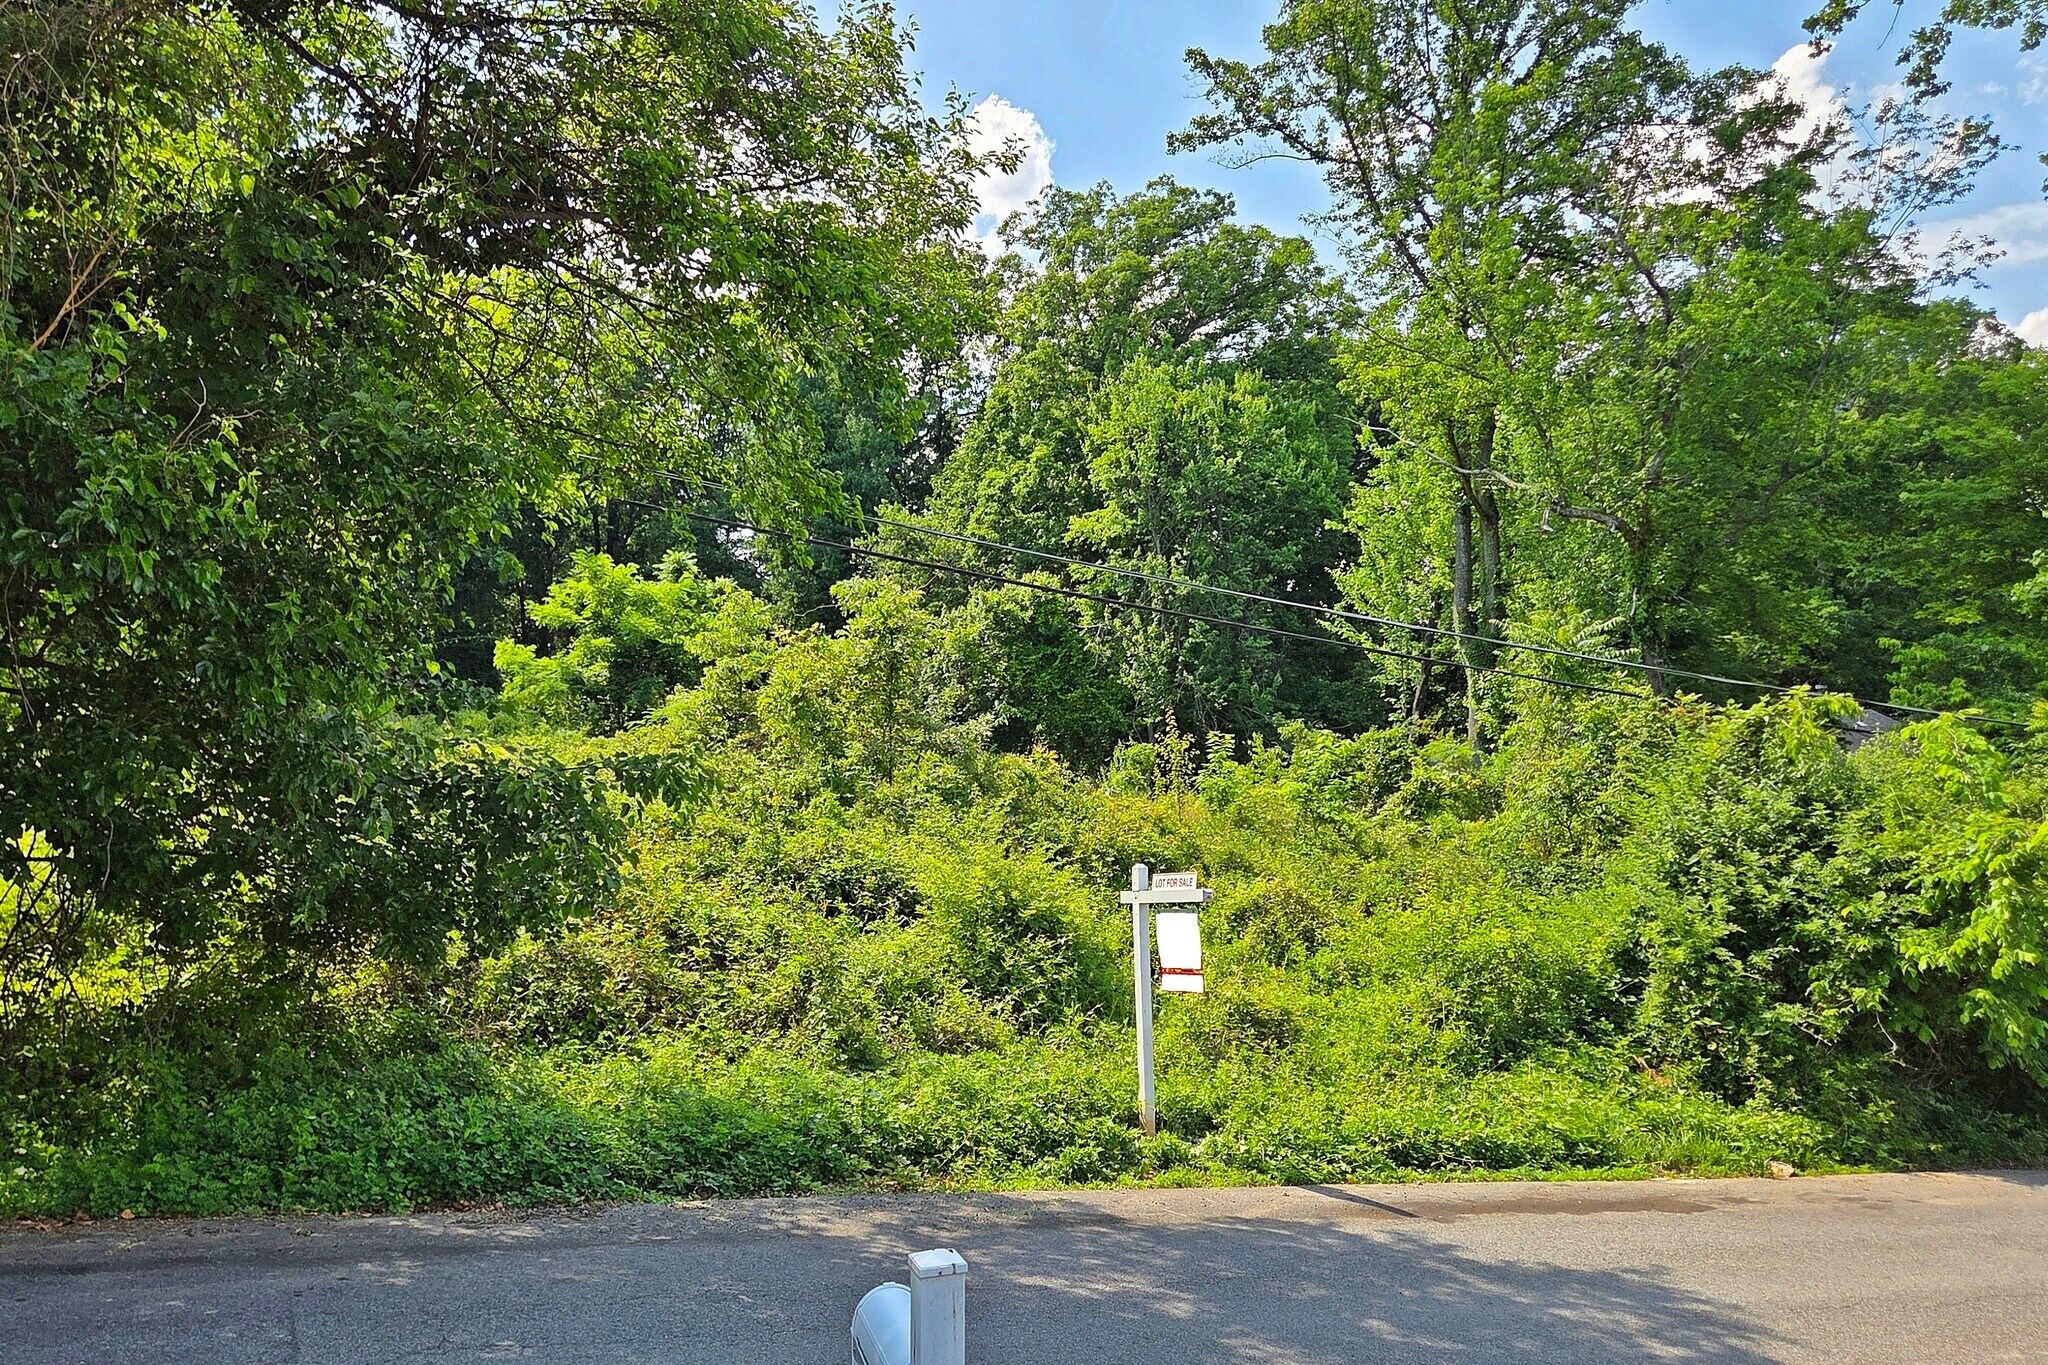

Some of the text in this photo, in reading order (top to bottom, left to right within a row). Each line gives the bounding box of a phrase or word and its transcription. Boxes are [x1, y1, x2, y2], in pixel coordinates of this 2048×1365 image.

[1155, 877, 1194, 888] LOT FOR SALE
